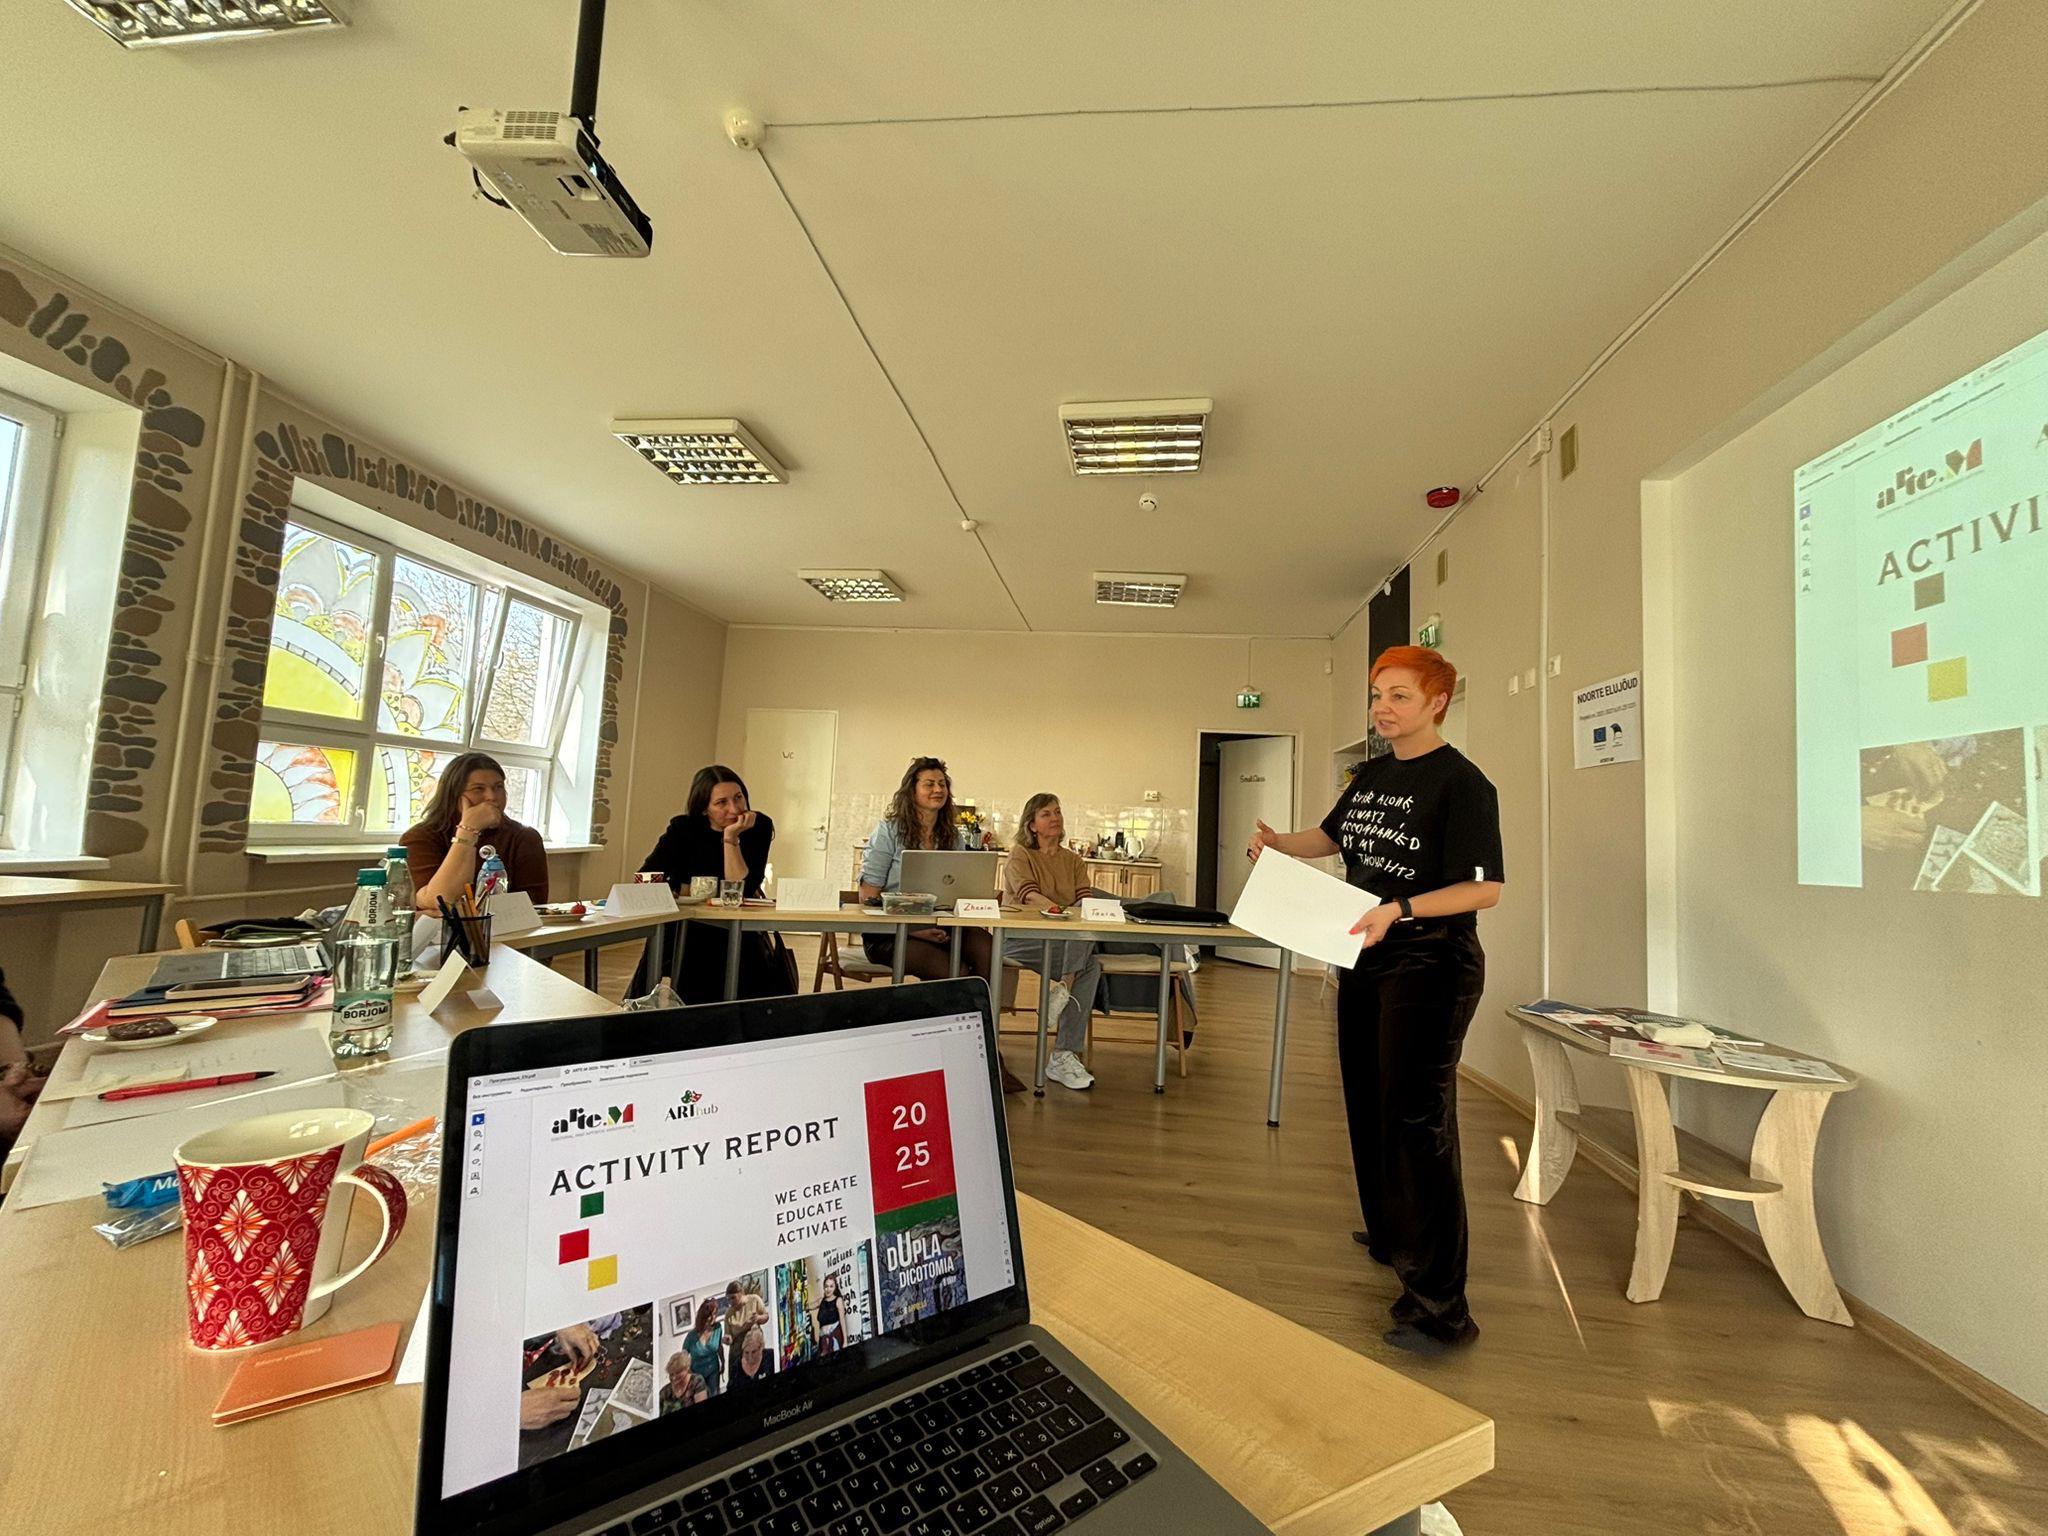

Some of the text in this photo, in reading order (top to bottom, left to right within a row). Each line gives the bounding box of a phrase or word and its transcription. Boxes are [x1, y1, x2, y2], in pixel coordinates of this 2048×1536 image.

[1877, 494, 2048, 586] ACTIVI
[1577, 677, 1638, 704] NOORTE ELUJÕUD
[1342, 834, 1375, 853] BY MY
[368, 891, 378, 924] BORJOMI
[892, 1101, 927, 1130] 20
[550, 1116, 839, 1196] ACTIVITY REPORT
[895, 1140, 930, 1172] 25
[774, 1175, 858, 1205] WE CREATE
[776, 1197, 843, 1226] EDUCATE
[777, 1215, 848, 1247] ACTIVATE
[886, 1230, 941, 1272] DUPLA
[898, 1256, 955, 1289] DICOTOMIA
[763, 1400, 814, 1428] MacBook Air
[1034, 1514, 1056, 1531] option
